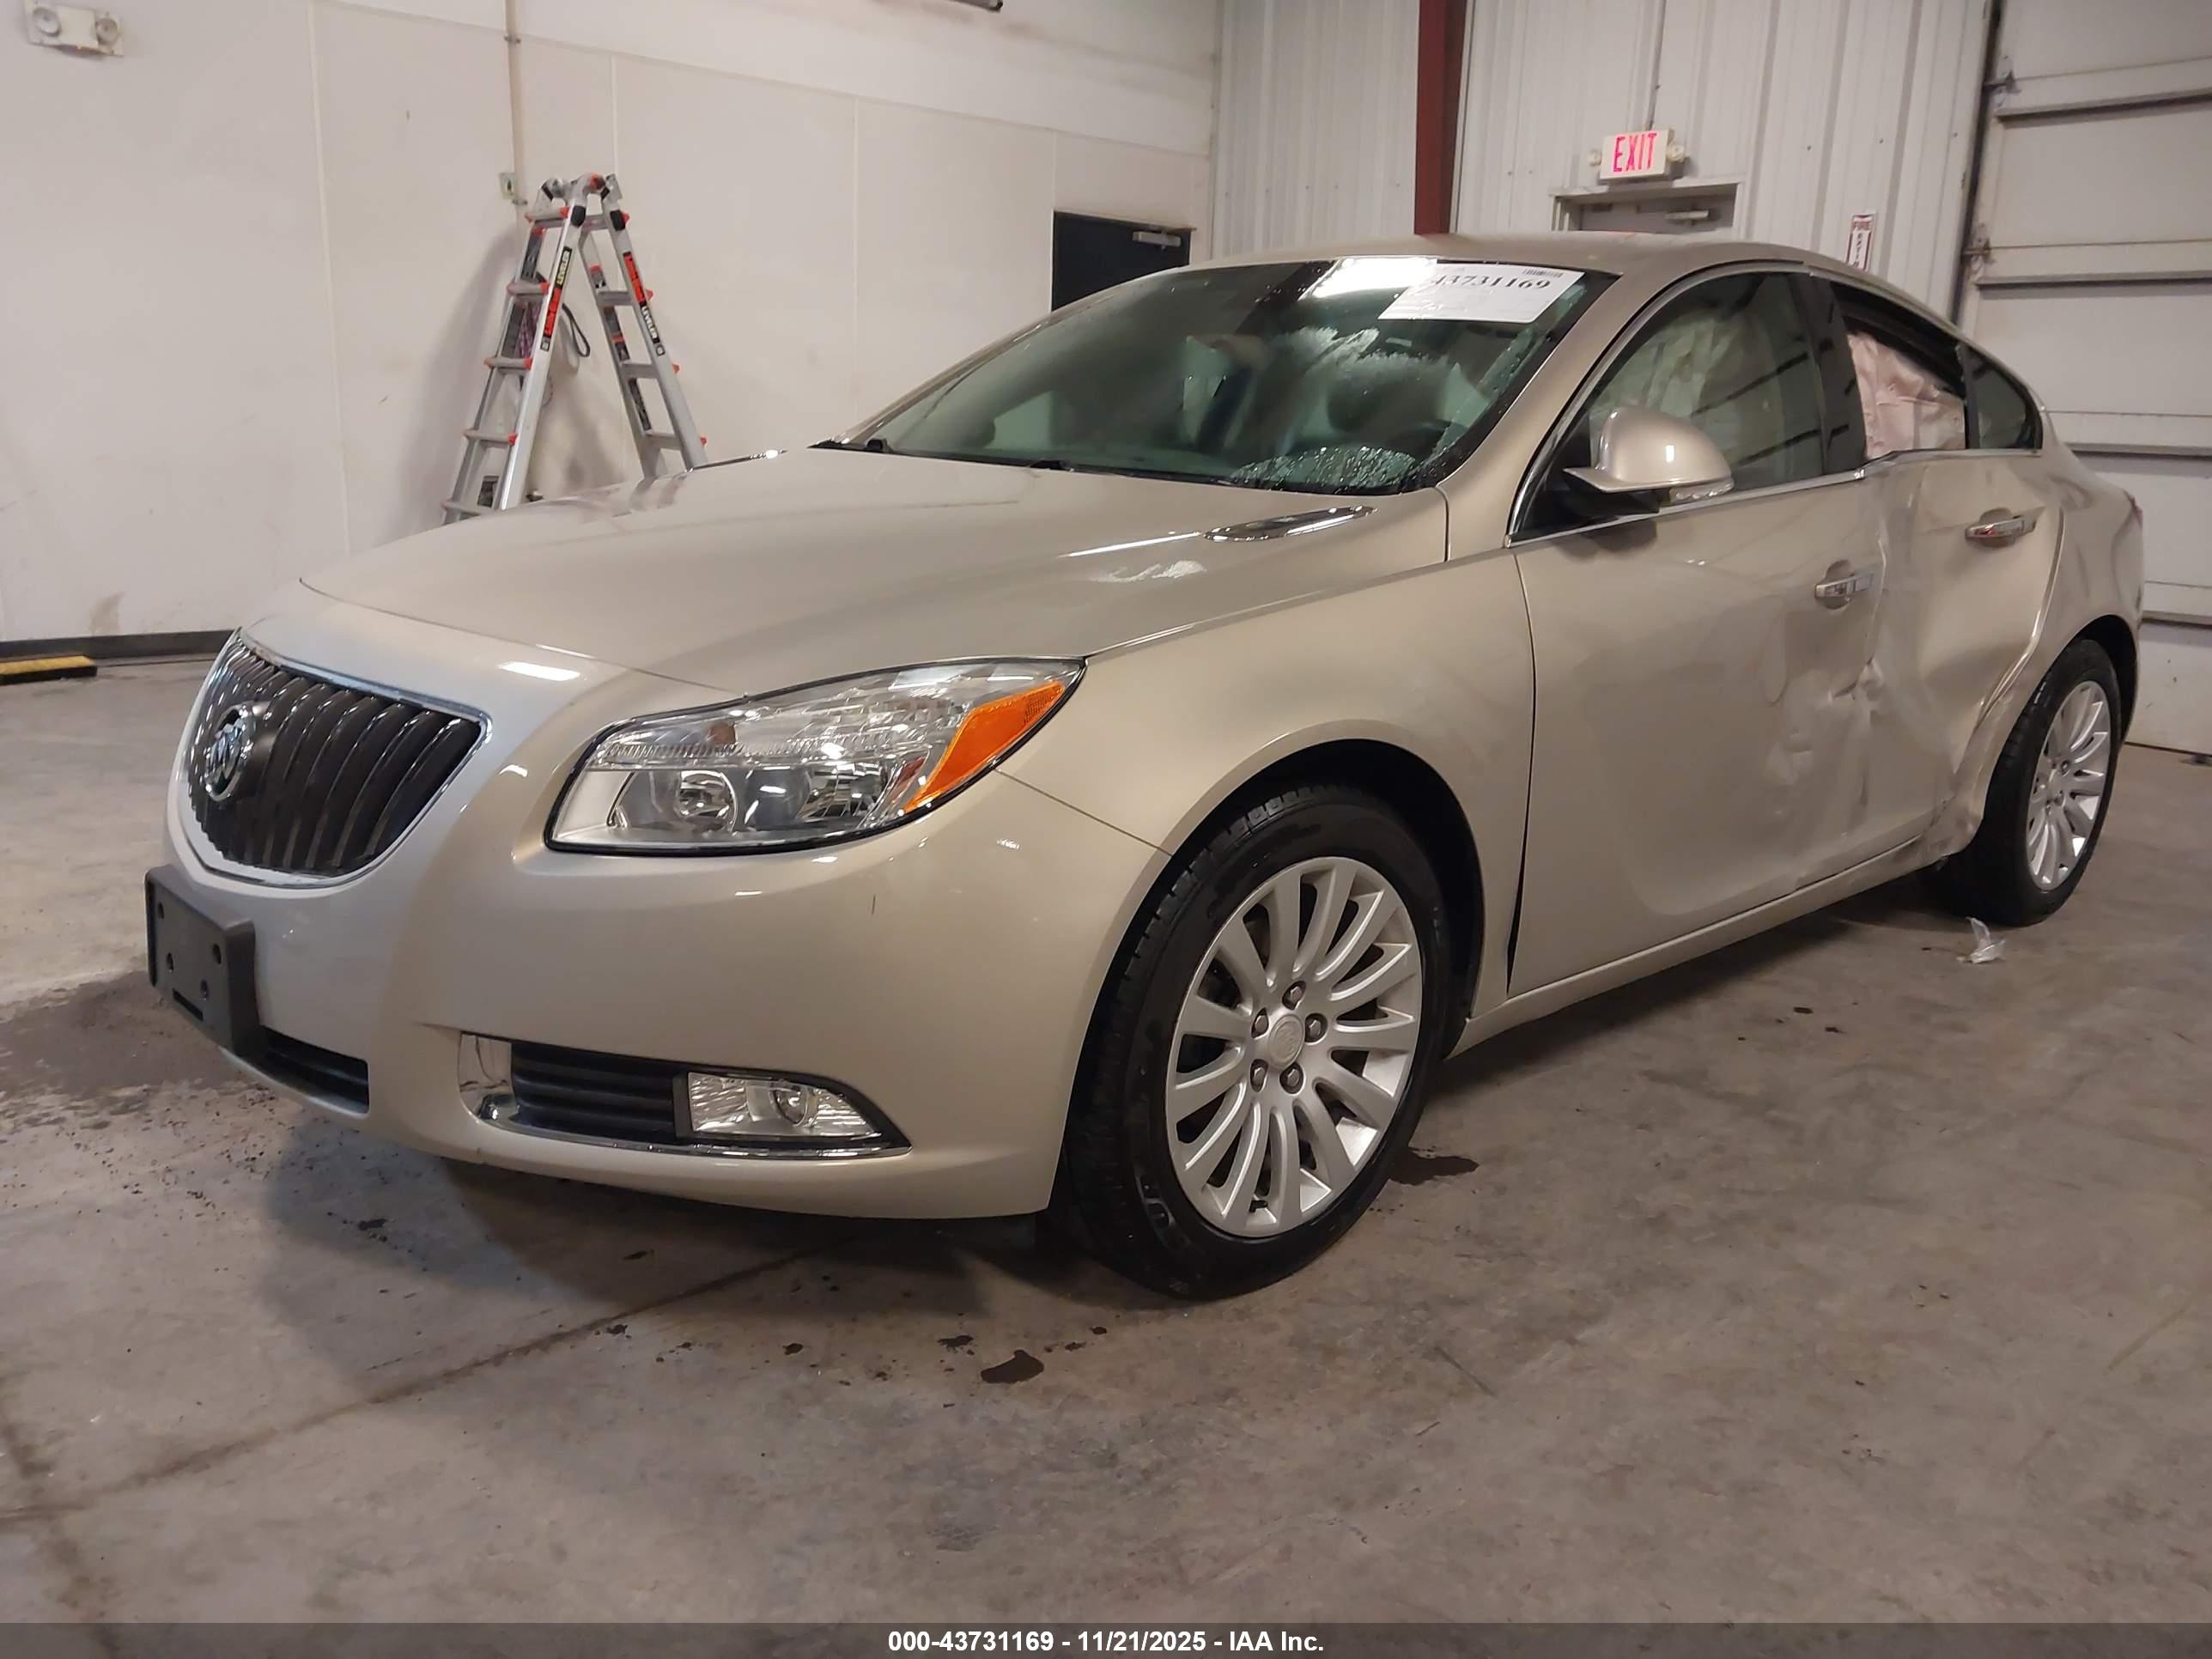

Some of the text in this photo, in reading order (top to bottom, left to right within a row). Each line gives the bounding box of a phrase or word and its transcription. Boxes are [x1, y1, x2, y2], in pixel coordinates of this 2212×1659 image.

[1613, 132, 1657, 173] EXIT
[1431, 275, 1551, 289] 43731169
[641, 306, 659, 338] LEVELER
